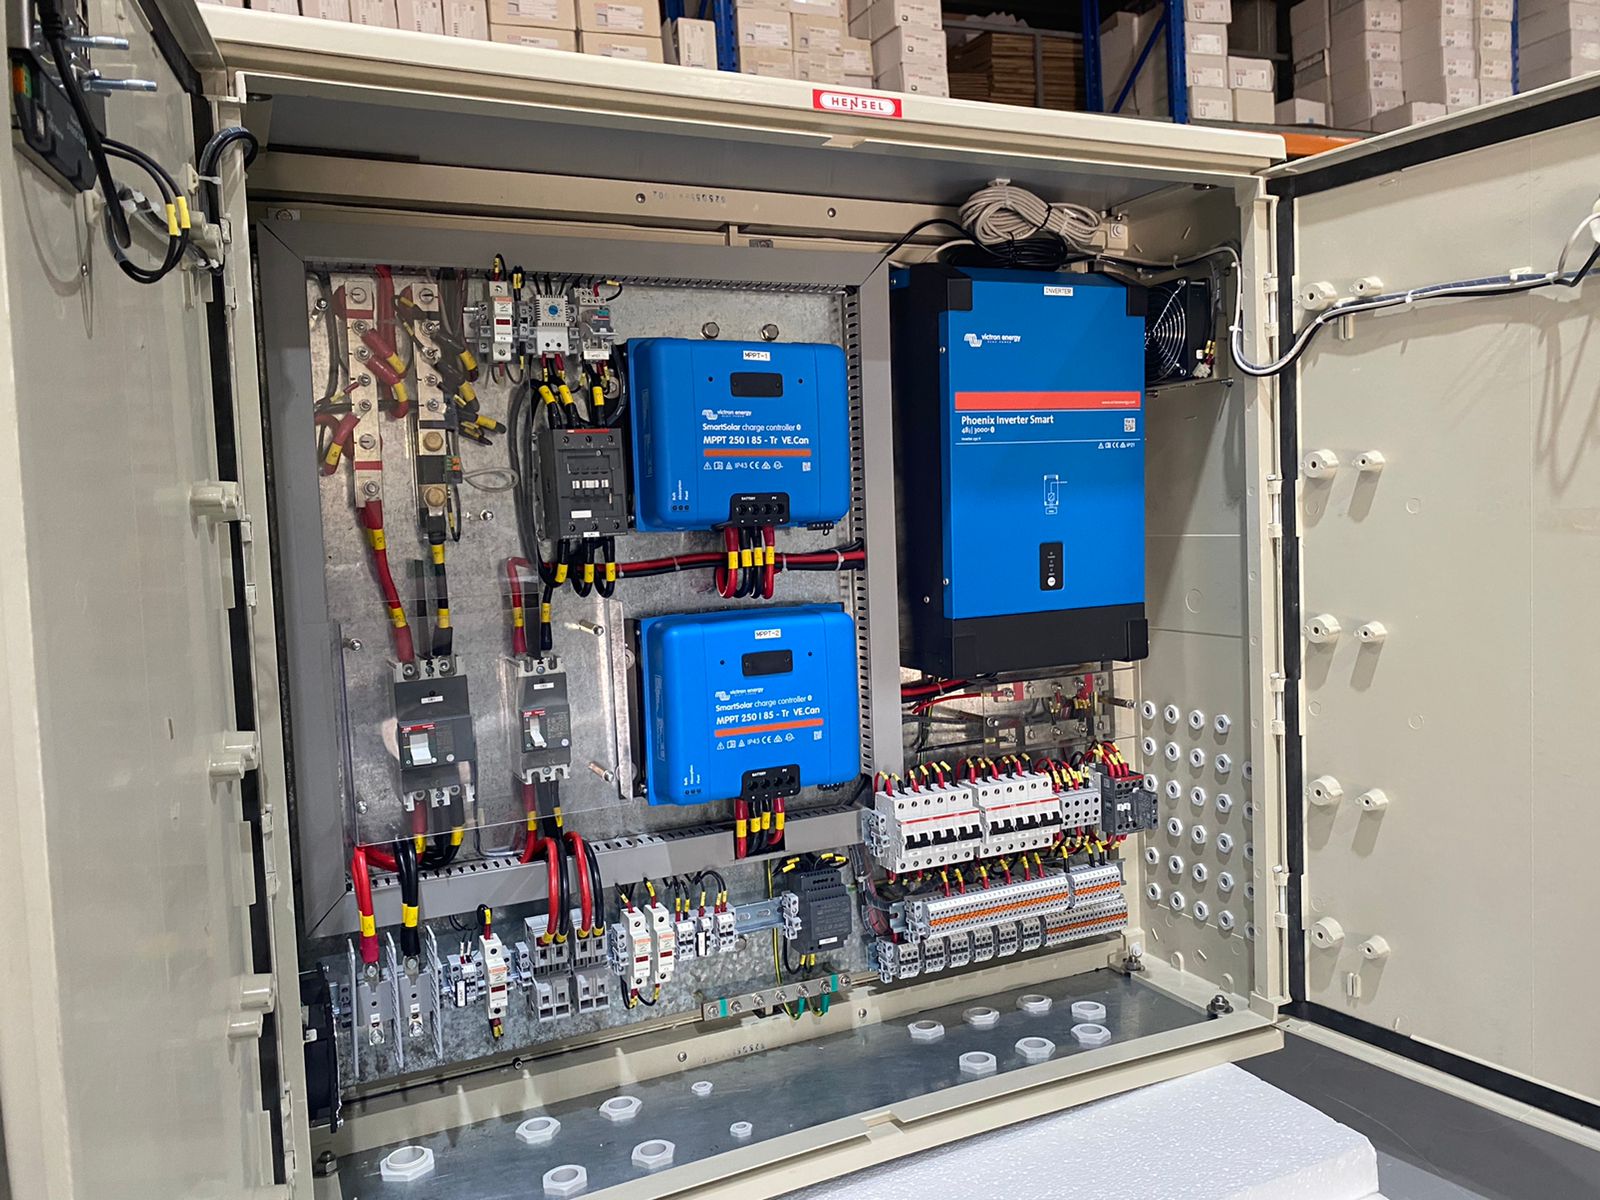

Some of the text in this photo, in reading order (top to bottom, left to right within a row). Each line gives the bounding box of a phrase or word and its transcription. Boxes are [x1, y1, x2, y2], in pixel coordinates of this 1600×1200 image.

[831, 97, 884, 110] HENSEL
[981, 333, 1001, 341] victron
[1001, 335, 1021, 343] energy
[961, 415, 1054, 425] Phoenix Inverter Smart
[702, 423, 741, 431] SmartSolar
[741, 424, 765, 433] charge
[703, 436, 727, 445] MPPT
[728, 436, 745, 444] 250
[751, 436, 762, 445] 85
[769, 436, 778, 444] Tr
[781, 436, 810, 445] VE.Can
[734, 461, 748, 469] IP43
[756, 629, 780, 638] MPPT-2
[715, 695, 806, 712] SmartSolar charge controller
[716, 715, 739, 725] MPPT
[741, 713, 758, 722] 250
[763, 711, 774, 719] 85
[782, 709, 790, 717] Tr
[793, 707, 821, 716] VE.Can
